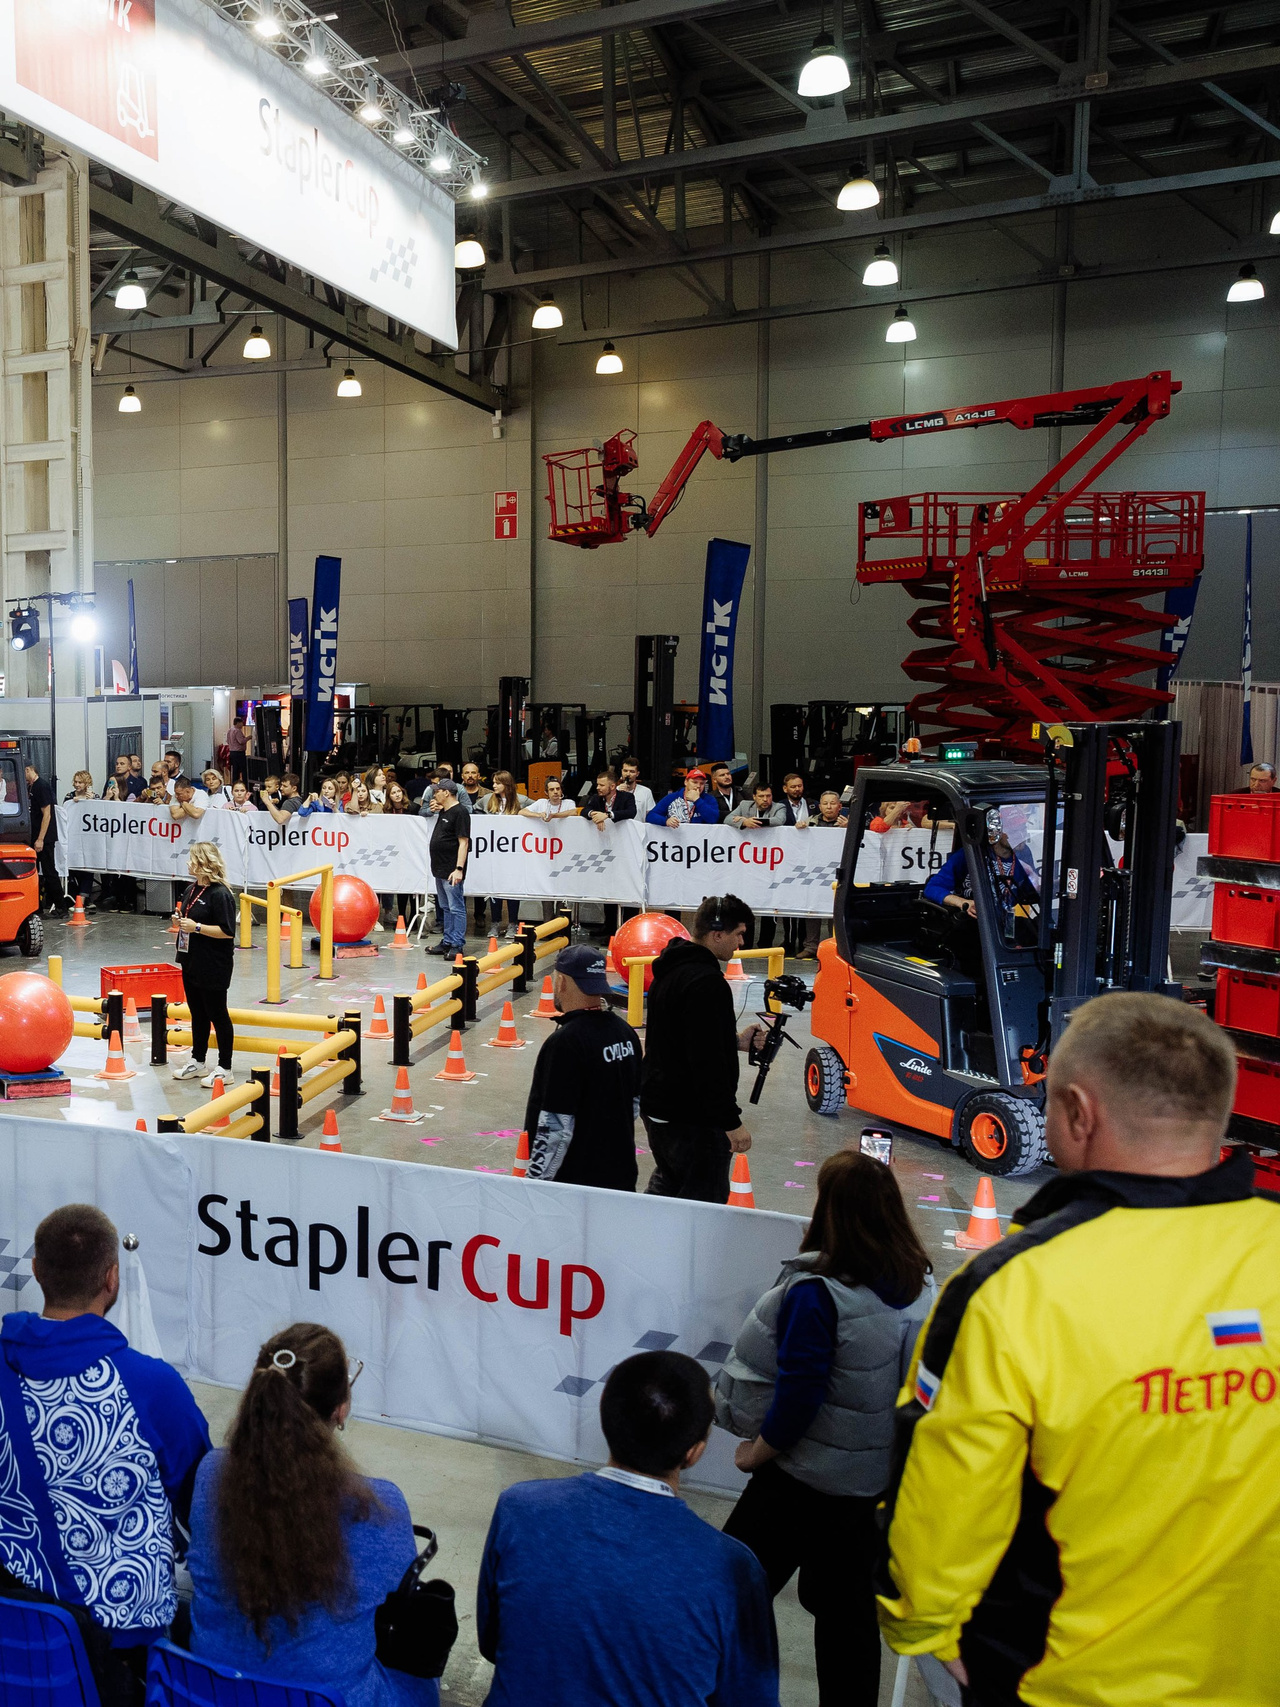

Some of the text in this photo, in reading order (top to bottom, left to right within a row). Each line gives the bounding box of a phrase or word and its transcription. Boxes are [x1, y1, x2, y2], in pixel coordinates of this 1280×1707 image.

[258, 98, 380, 238] StaplerCup
[905, 409, 996, 430] LCMG A14JE
[82, 812, 182, 844] StaplerCup
[247, 825, 350, 853] taplerCup
[646, 837, 785, 871] StaplerCup
[901, 846, 948, 870] Sta
[602, 1040, 635, 1063] СУДЬЯ
[899, 1057, 933, 1076] Linde
[197, 1193, 606, 1338] StaplerCup
[1133, 1367, 1280, 1415] ПЕТРО
